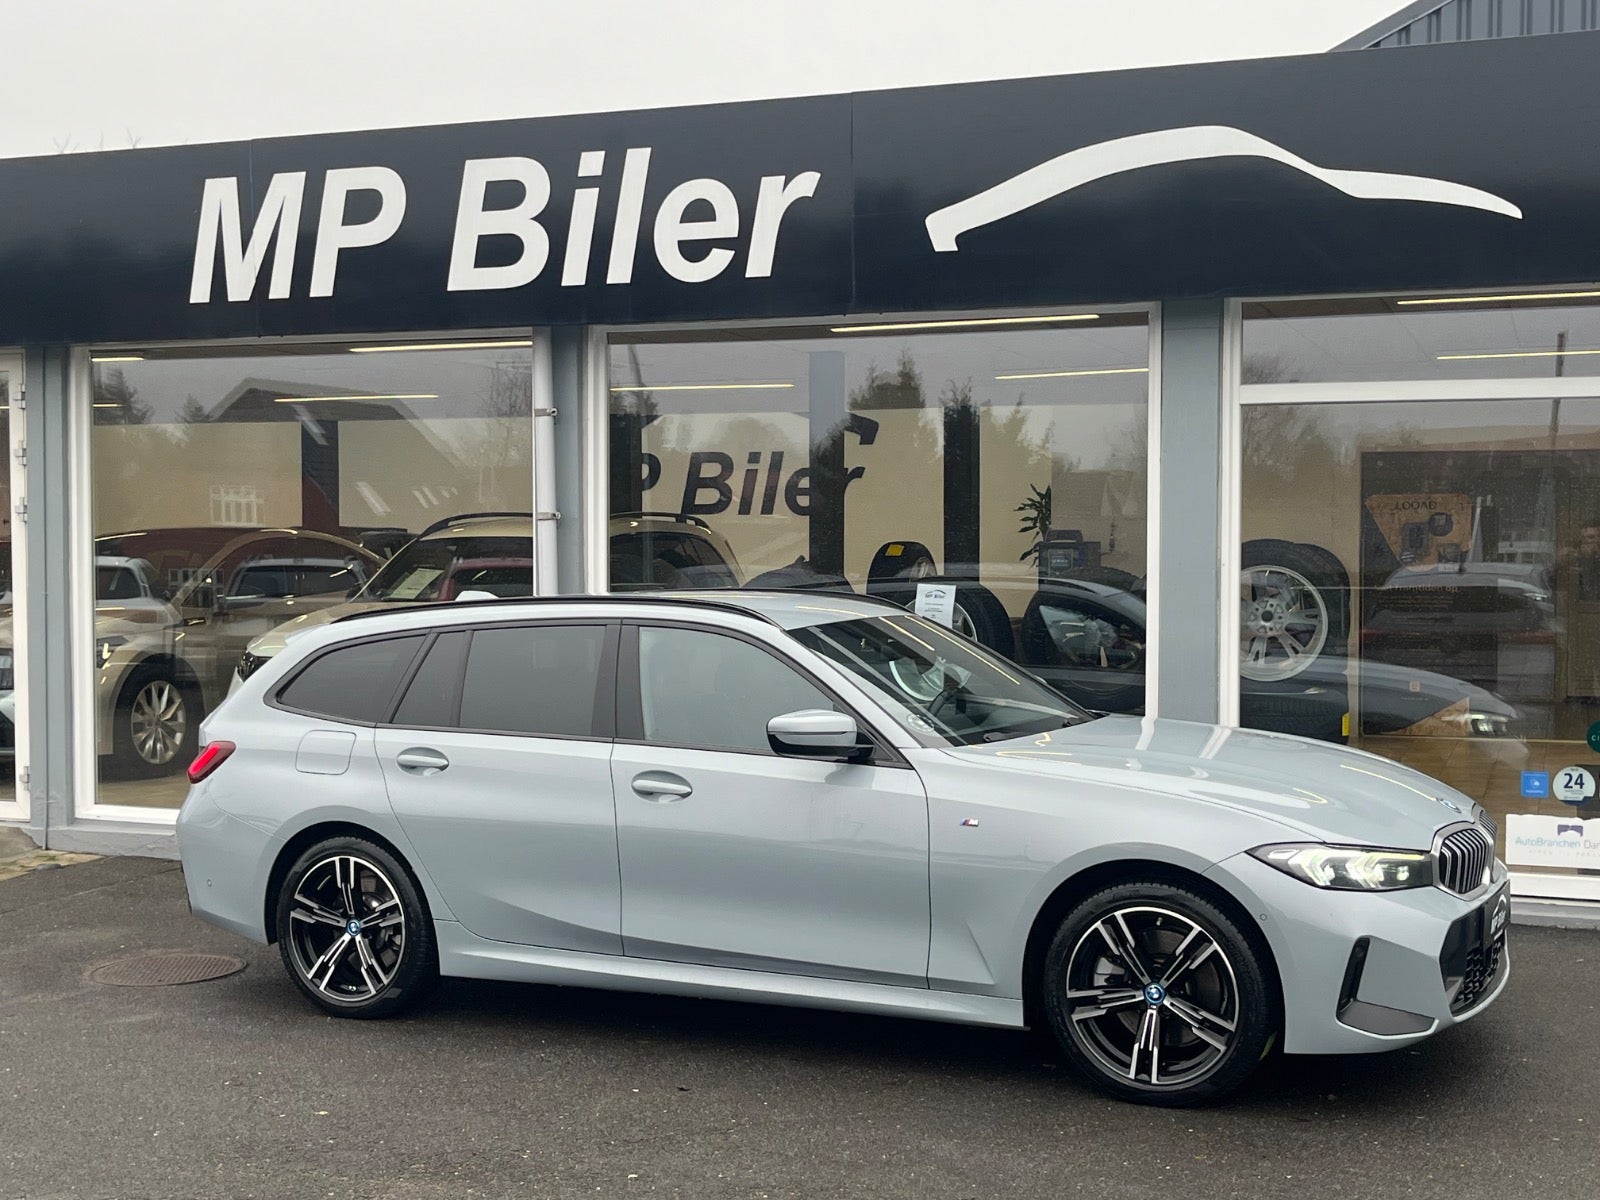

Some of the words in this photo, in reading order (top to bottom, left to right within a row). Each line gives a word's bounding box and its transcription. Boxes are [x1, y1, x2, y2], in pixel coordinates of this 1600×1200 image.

[189, 166, 407, 304] MP
[447, 147, 821, 292] Biler
[1564, 773, 1584, 789] 24
[1516, 836, 1580, 850] AutoBranchen
